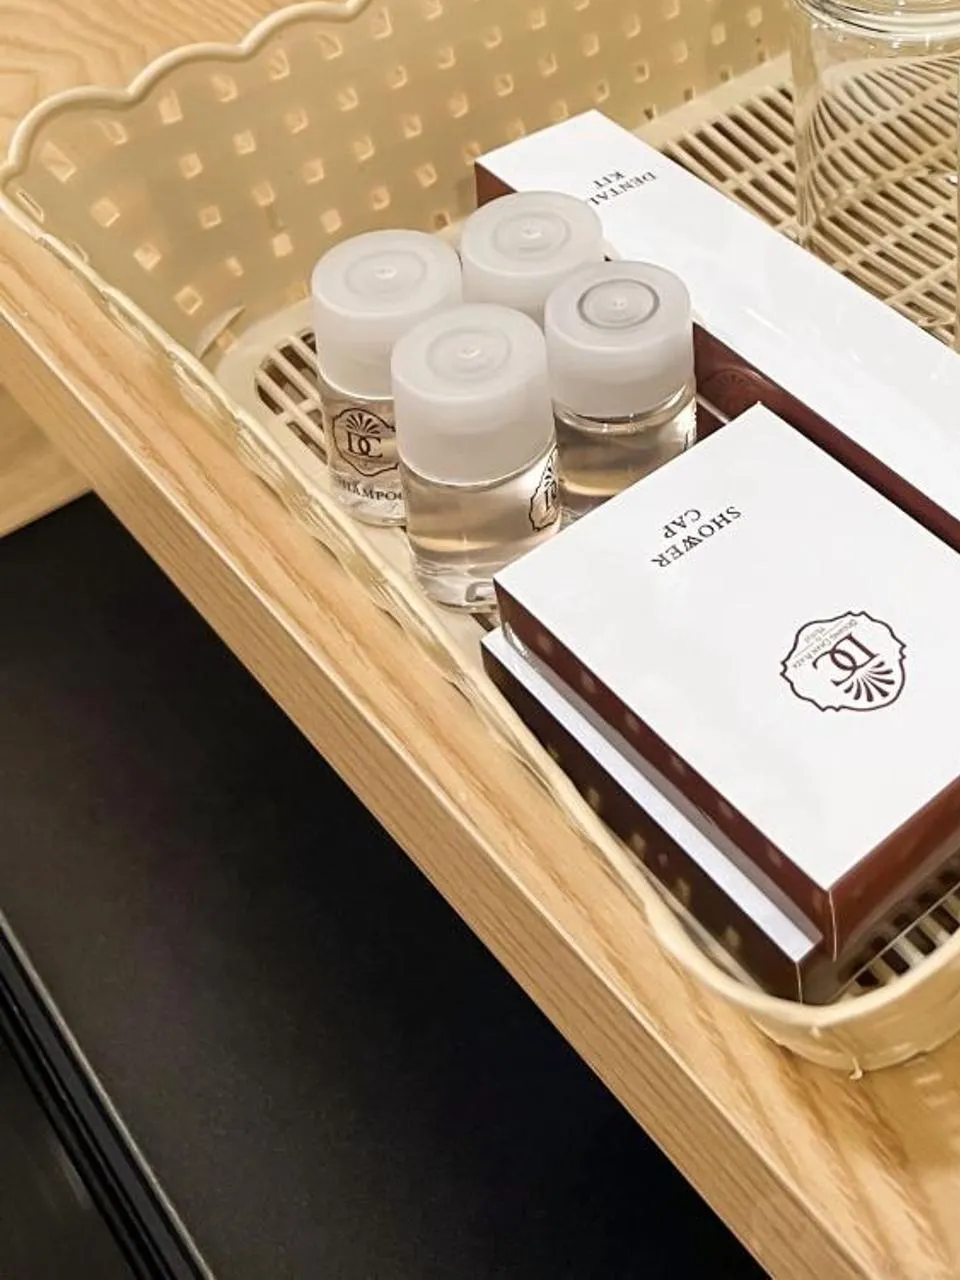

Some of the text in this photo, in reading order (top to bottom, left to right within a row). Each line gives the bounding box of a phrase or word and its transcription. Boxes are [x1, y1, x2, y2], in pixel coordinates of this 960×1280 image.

[590, 171, 656, 205] DENTAL
[593, 171, 625, 188] KIT
[650, 506, 742, 567] SHOWER
[663, 508, 702, 538] CAP
